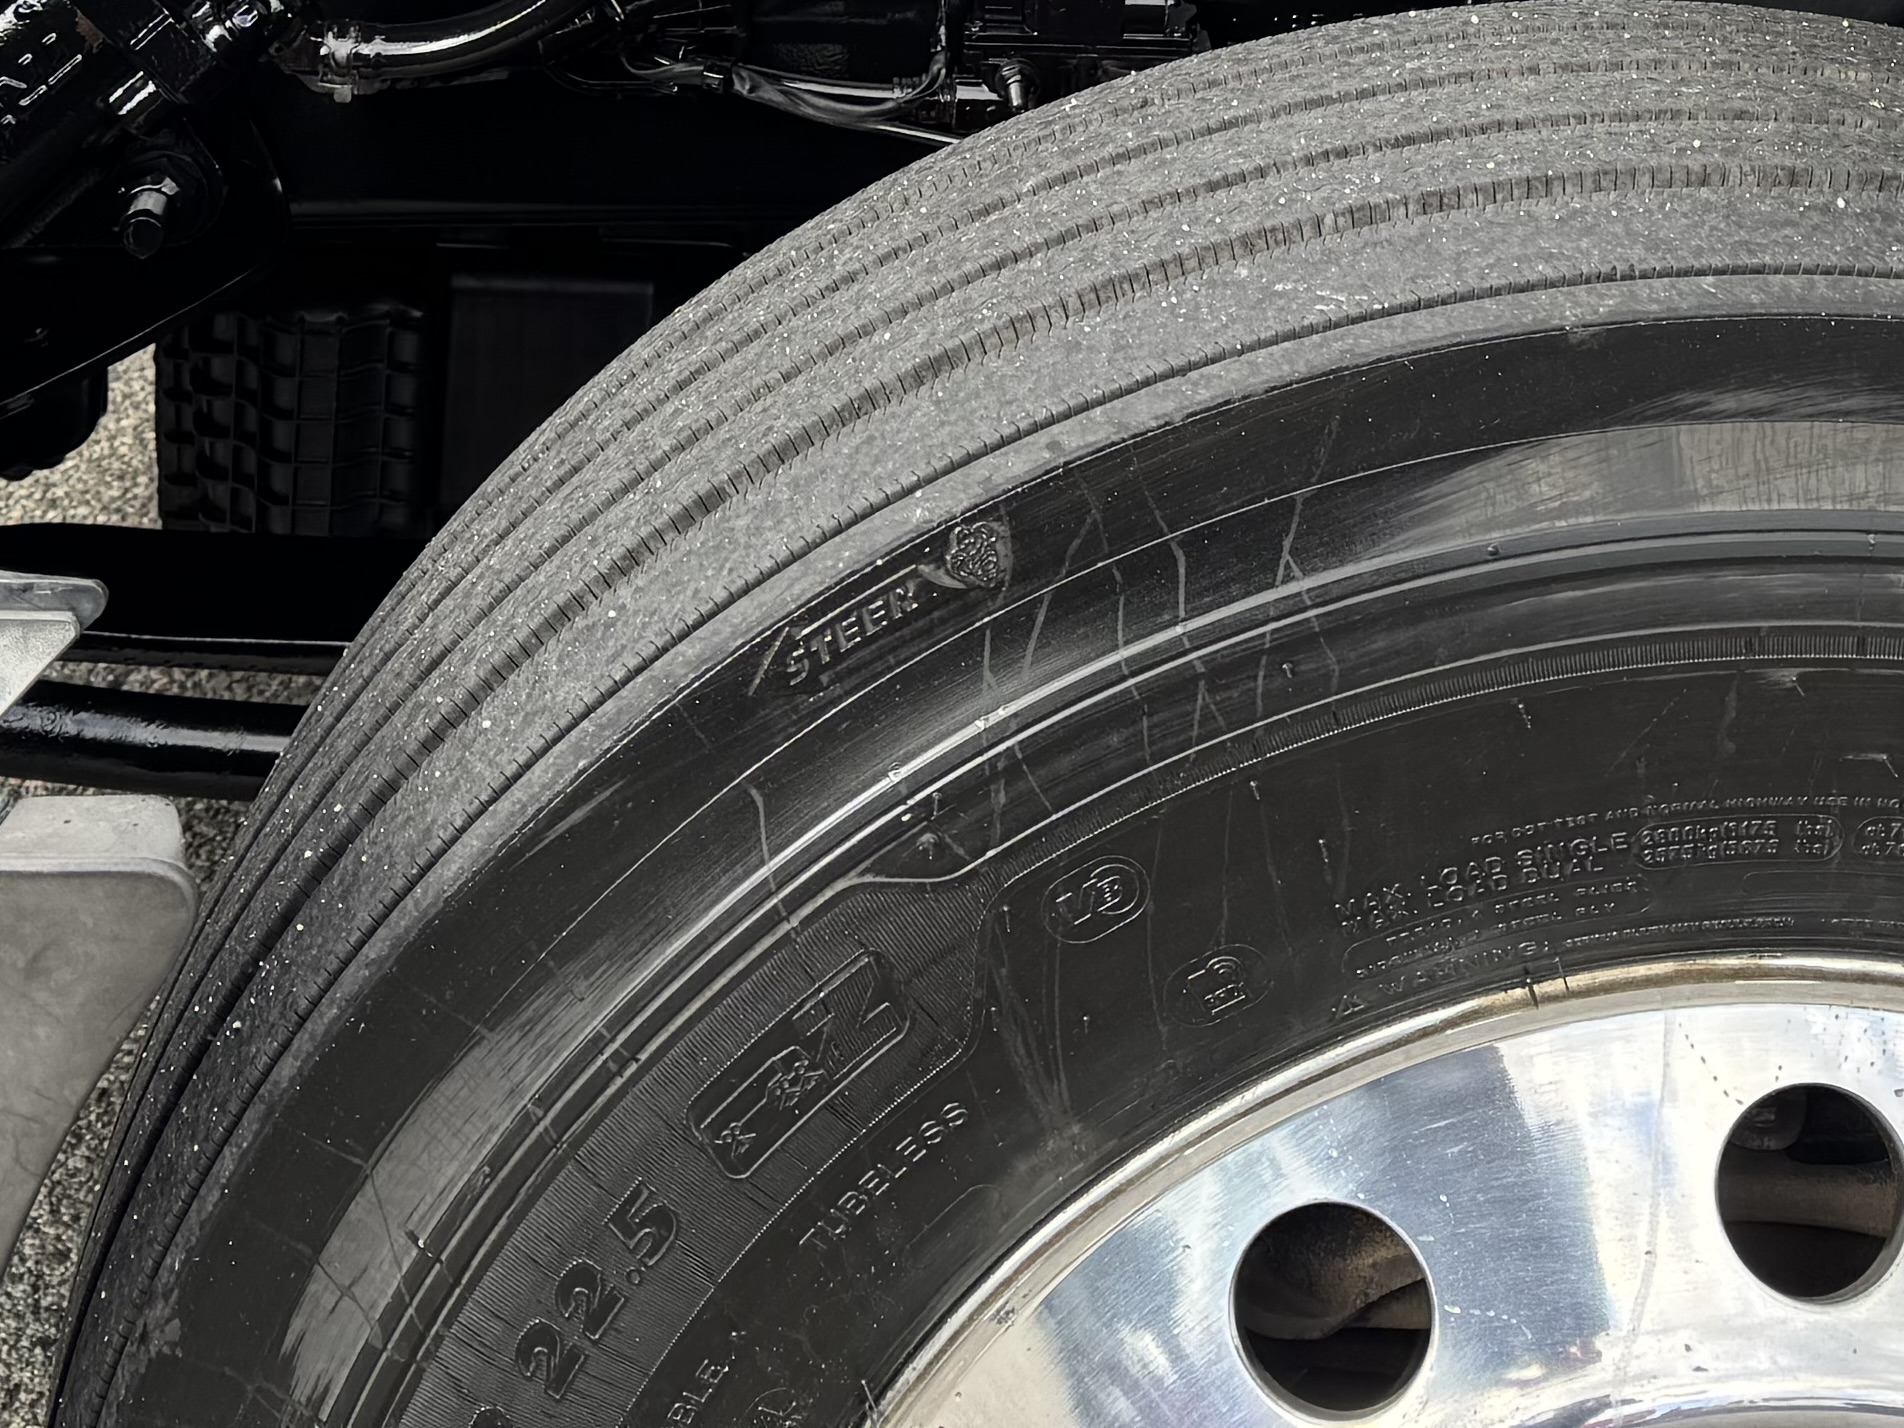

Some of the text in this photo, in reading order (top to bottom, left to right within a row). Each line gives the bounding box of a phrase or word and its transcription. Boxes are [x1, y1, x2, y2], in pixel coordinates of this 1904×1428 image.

[786, 574, 920, 687] STEER
[1516, 831, 1629, 866] SINGLE
[1813, 796, 1848, 807] USE
[798, 1100, 971, 1252] TUBELESS
[514, 1176, 679, 1400] 22.5
